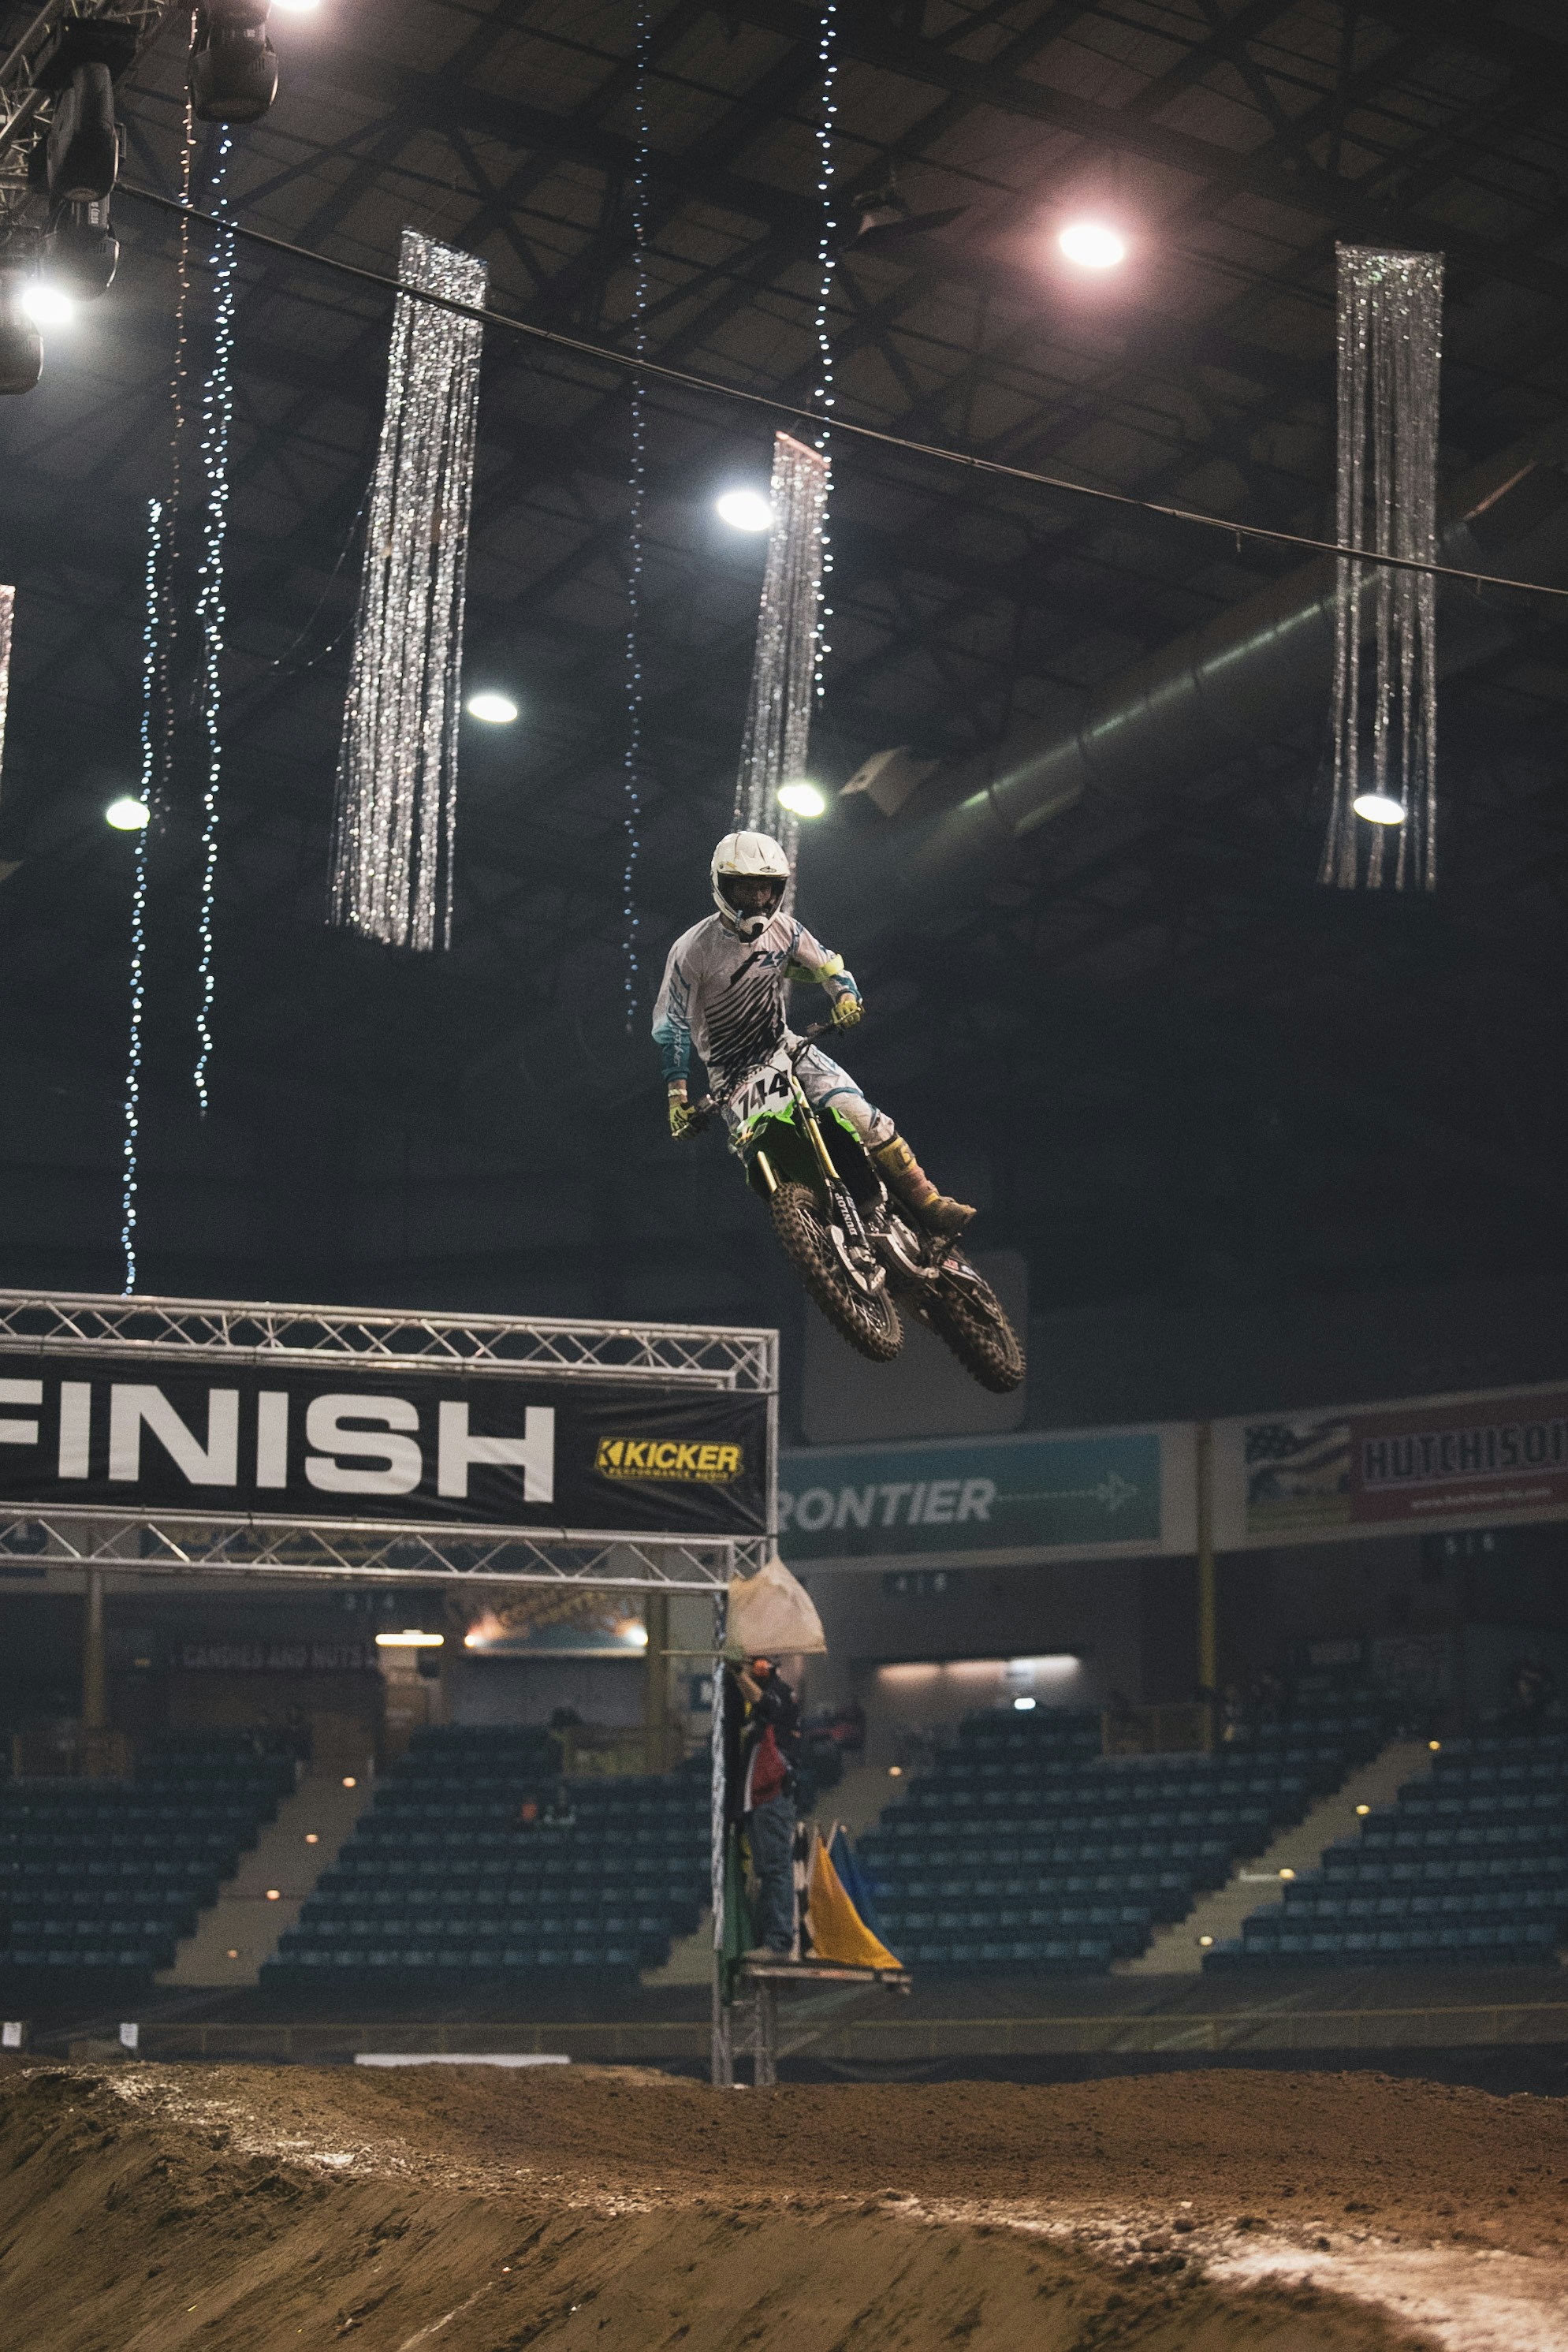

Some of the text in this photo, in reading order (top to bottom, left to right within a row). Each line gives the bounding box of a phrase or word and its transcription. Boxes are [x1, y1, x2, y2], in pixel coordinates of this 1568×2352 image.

[834, 1192, 858, 1236] DUNLOP
[624, 1441, 740, 1472] KICKER
[778, 1477, 996, 1533] RONTIER
